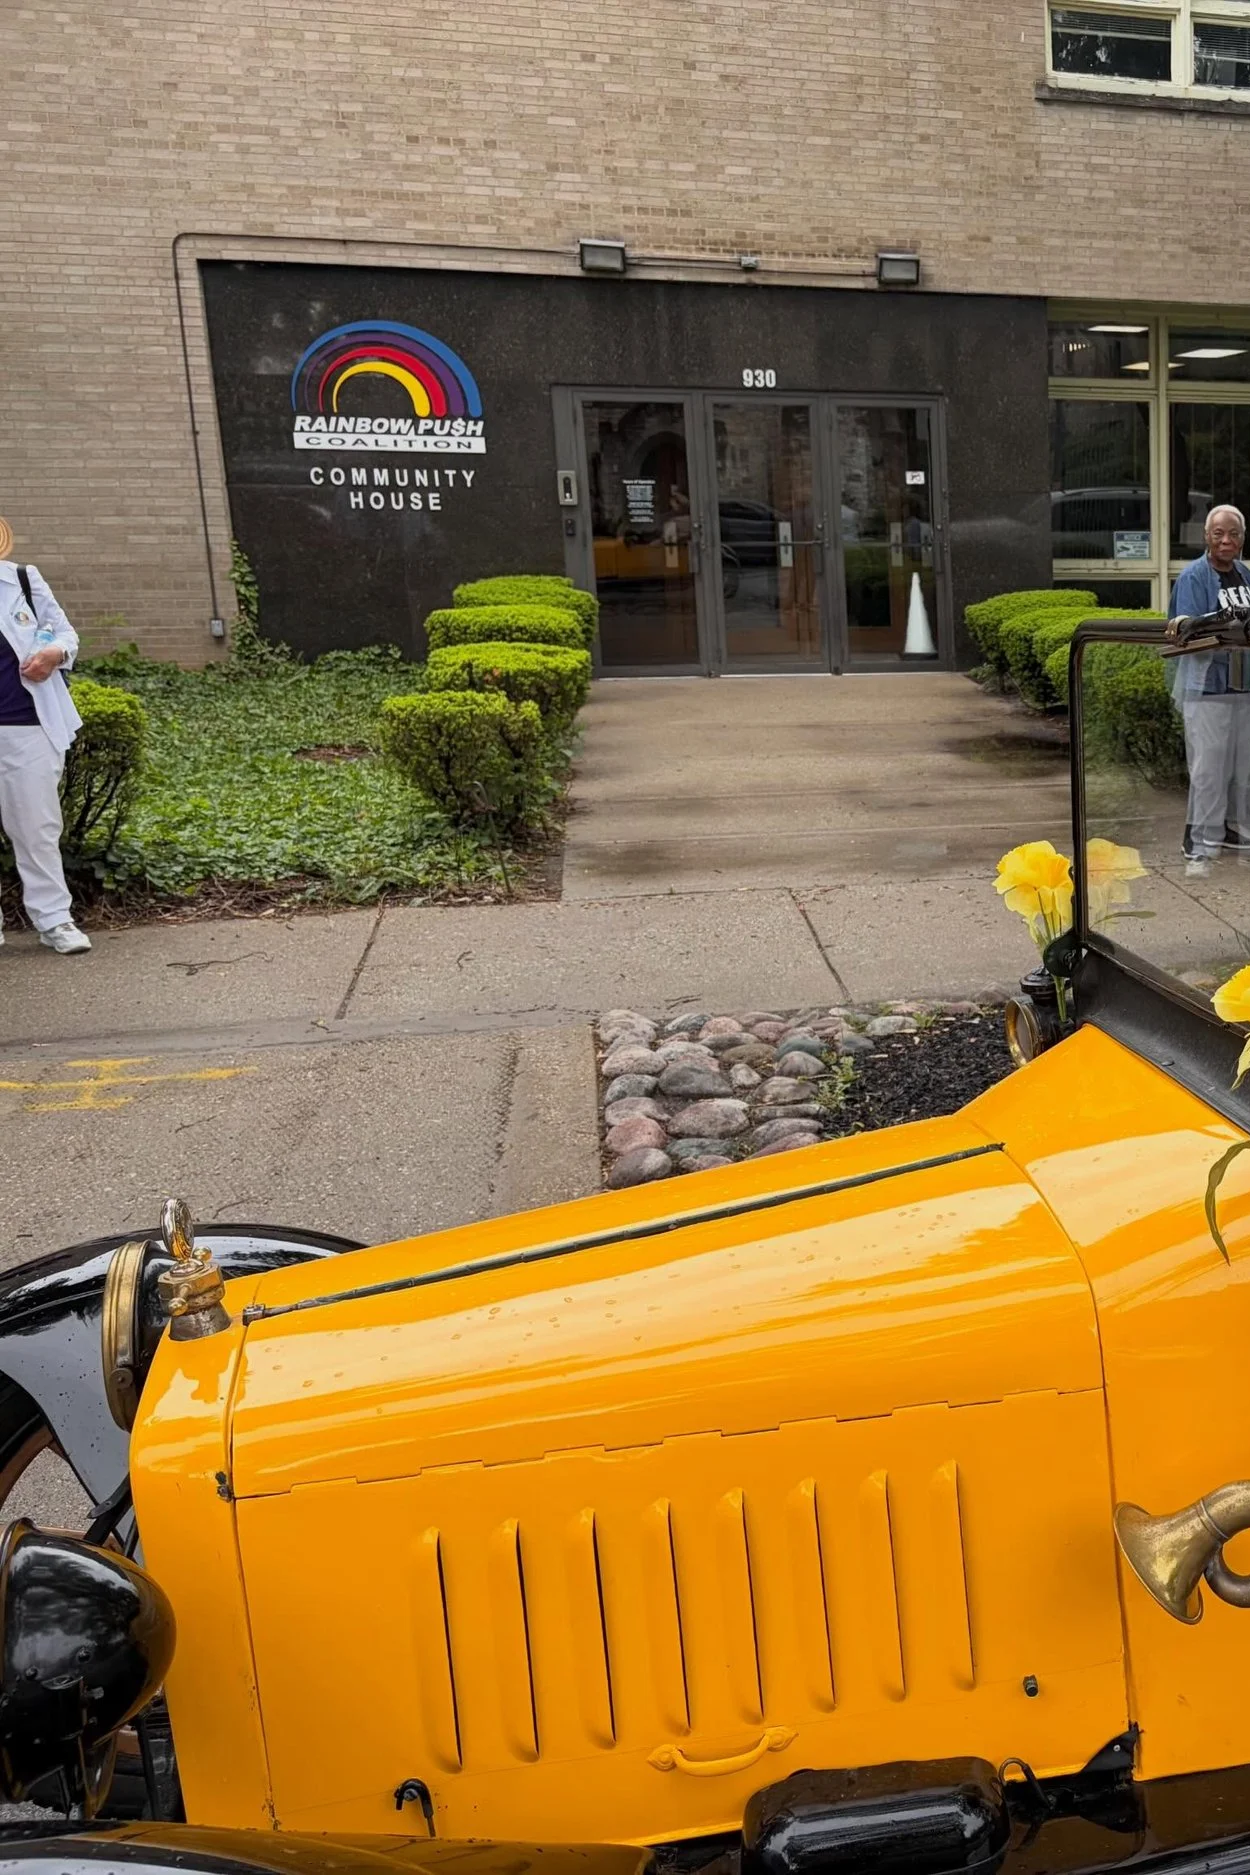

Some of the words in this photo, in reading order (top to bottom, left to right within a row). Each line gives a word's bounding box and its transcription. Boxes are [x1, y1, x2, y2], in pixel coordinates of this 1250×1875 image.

[743, 368, 776, 388] 930
[294, 415, 413, 435] RAINBOW
[305, 436, 473, 449] COALITION
[309, 467, 475, 488] COMMUNITY
[349, 491, 442, 511] HOUSE
